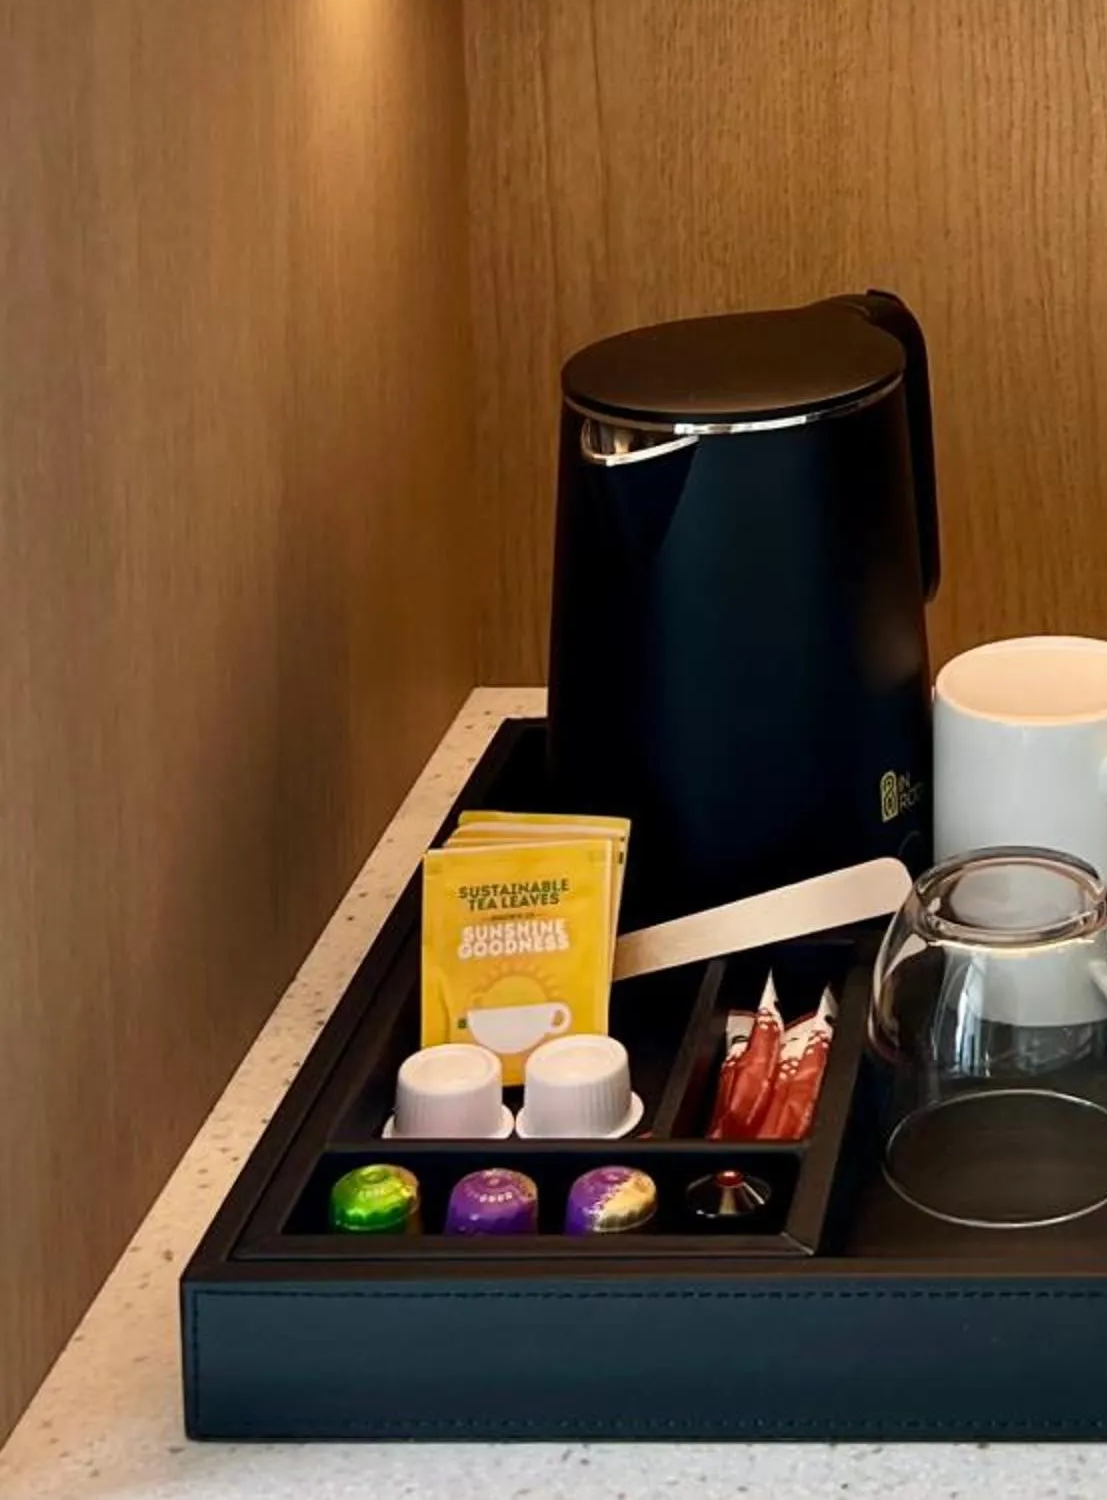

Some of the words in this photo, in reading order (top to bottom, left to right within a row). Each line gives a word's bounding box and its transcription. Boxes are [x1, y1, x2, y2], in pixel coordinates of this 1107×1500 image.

[458, 878, 569, 899] SUSTAINABLE
[468, 895, 498, 911] TEA
[501, 891, 560, 909] LEAVES
[462, 918, 567, 943] SUNSHINE
[458, 932, 569, 959] GOODNESS
